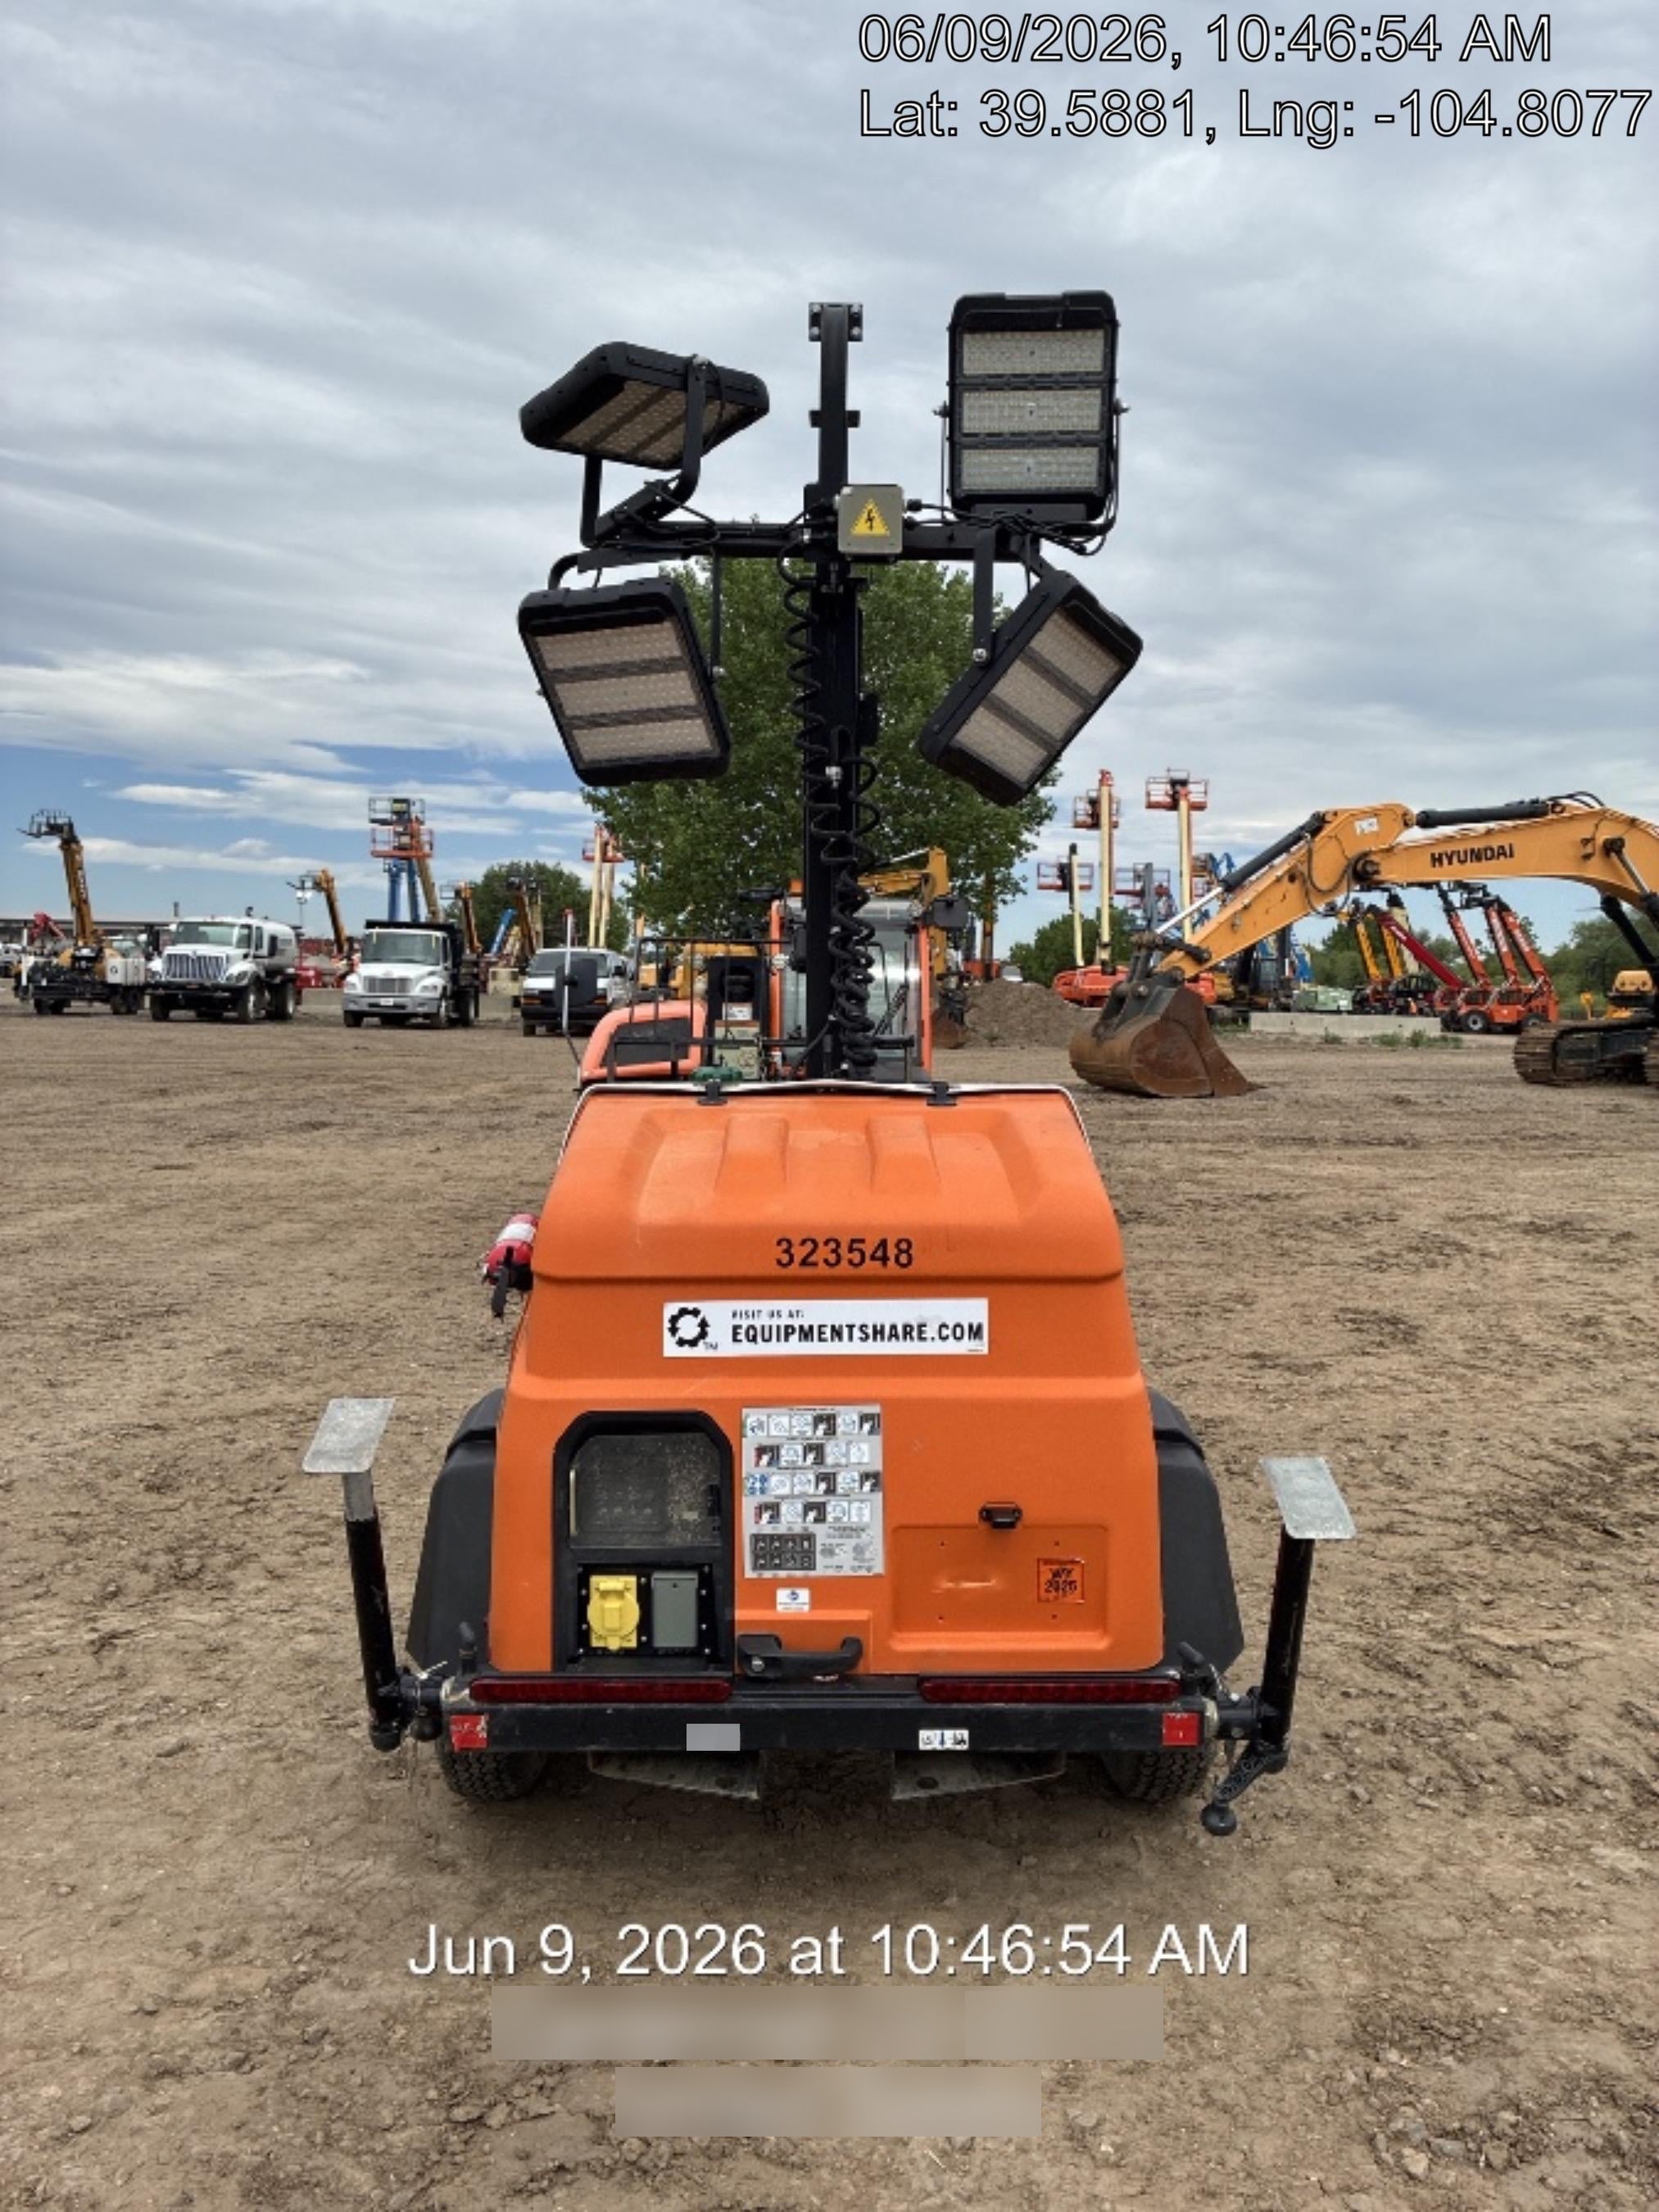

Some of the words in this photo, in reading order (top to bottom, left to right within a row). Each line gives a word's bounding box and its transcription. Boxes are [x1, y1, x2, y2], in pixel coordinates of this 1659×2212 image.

[1430, 842, 1515, 868] HYUNDAI
[775, 1238, 913, 1269] 323548
[768, 1309, 782, 1319] US
[731, 1322, 984, 1344] EQUIPMENTSHARE.COM
